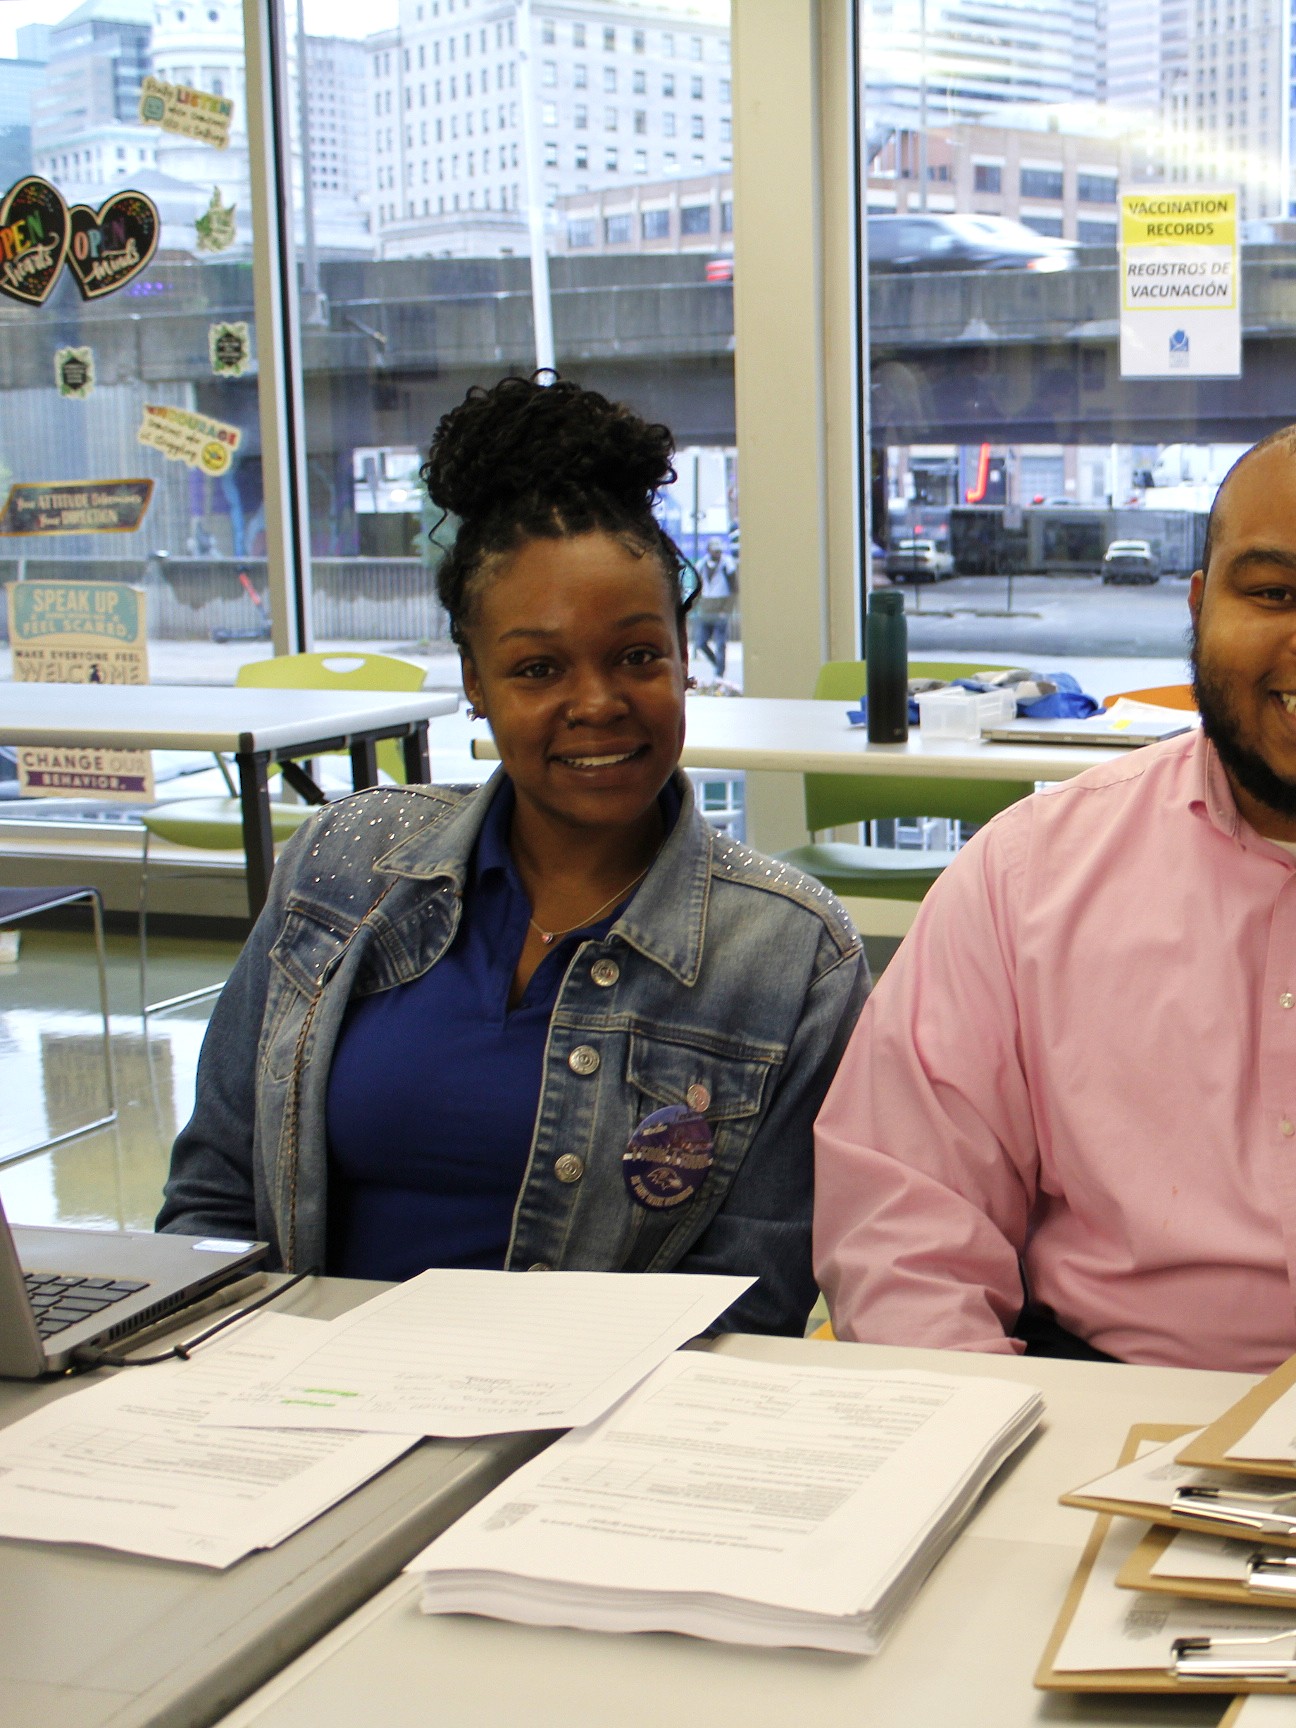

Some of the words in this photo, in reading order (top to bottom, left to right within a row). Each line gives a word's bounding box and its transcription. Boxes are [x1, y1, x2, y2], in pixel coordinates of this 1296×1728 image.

[1128, 200, 1228, 215] VACCINATION
[0, 210, 45, 263] PEN
[1147, 223, 1214, 237] RECORDS
[1127, 262, 1207, 277] REGISTROS
[1211, 262, 1230, 275] DE
[1131, 281, 1228, 298] VACUNACIÓN
[37, 493, 89, 509] ATTITUDE
[32, 588, 90, 613] SPEAK
[94, 590, 119, 614] UP
[23, 620, 56, 635] FEEL
[15, 650, 44, 660] MAKE
[50, 650, 108, 661] EVERYONE
[22, 751, 104, 771] CHANGE
